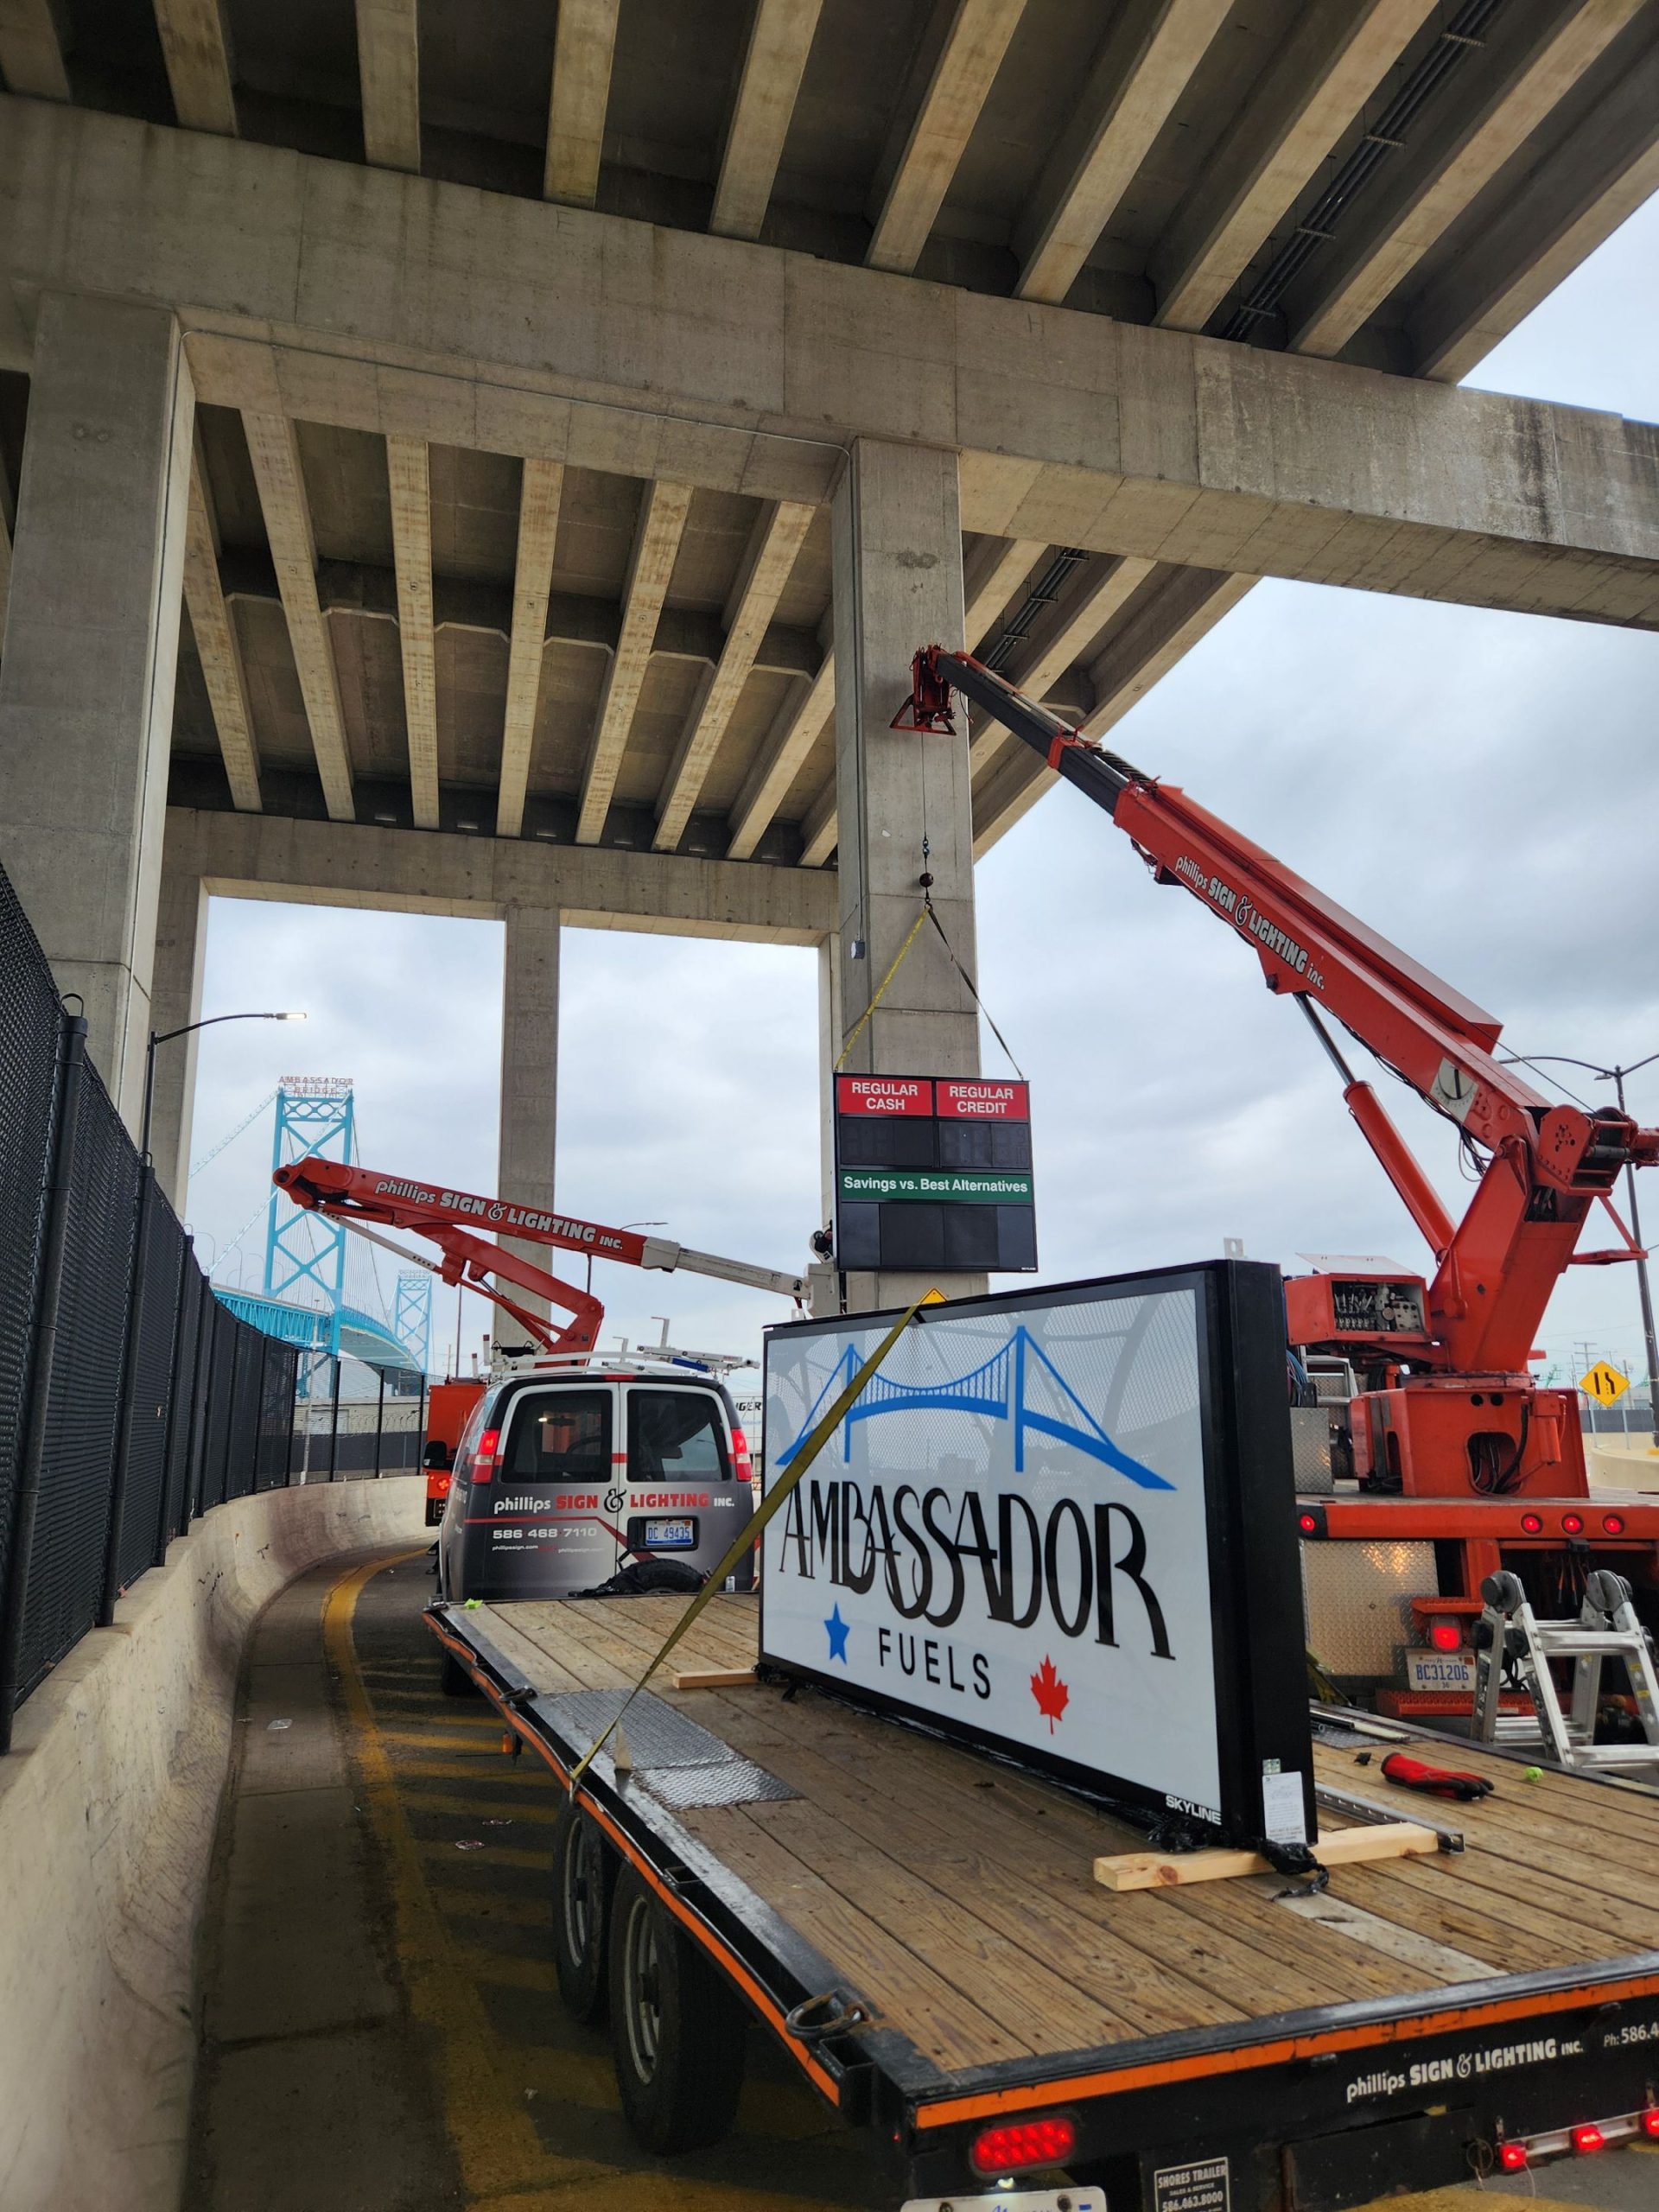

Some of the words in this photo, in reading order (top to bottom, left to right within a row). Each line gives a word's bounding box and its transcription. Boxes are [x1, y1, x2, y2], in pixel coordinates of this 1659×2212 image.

[1175, 856, 1208, 889] phillips
[1208, 876, 1237, 913] SIGN
[1235, 895, 1253, 926] &
[1248, 910, 1309, 974] LIGHTING
[1306, 963, 1325, 990] inc.
[852, 1082, 918, 1096] REGULAR
[950, 1086, 1014, 1100] REGULAR
[866, 1098, 905, 1110] CASH
[957, 1101, 1007, 1114] CREDIT
[843, 1176, 896, 1192] Savings
[899, 1179, 918, 1190] vs.
[920, 1179, 950, 1191] Best
[952, 1179, 1028, 1192] Alternatives
[375, 1179, 435, 1205] phillips
[439, 1192, 486, 1216] SIGN
[486, 1199, 507, 1221] &
[506, 1211, 596, 1243] LIGHTING
[599, 1235, 623, 1250] INC.
[493, 1497, 551, 1514] phillips
[556, 1495, 598, 1510] SIGN
[604, 1488, 626, 1513] &
[630, 1493, 709, 1508] LIGHTING
[714, 1497, 734, 1507] INC.
[779, 1479, 1176, 1661] AMBASSADOR
[878, 1628, 991, 1700] FUELS
[1415, 1664, 1470, 1681] BC31206
[1166, 1795, 1222, 1826] SKYLINE
[1604, 2032, 1619, 2047] Ph:
[1346, 2070, 1406, 2103] phillips
[1409, 2058, 1453, 2086] SIGN
[1456, 2053, 1472, 2078] &
[1475, 2038, 1557, 2073] LIGHTING
[1560, 2040, 1584, 2056] INC.
[1158, 2171, 1190, 2189] SHORES
[1192, 2164, 1227, 2182] TRAILER
